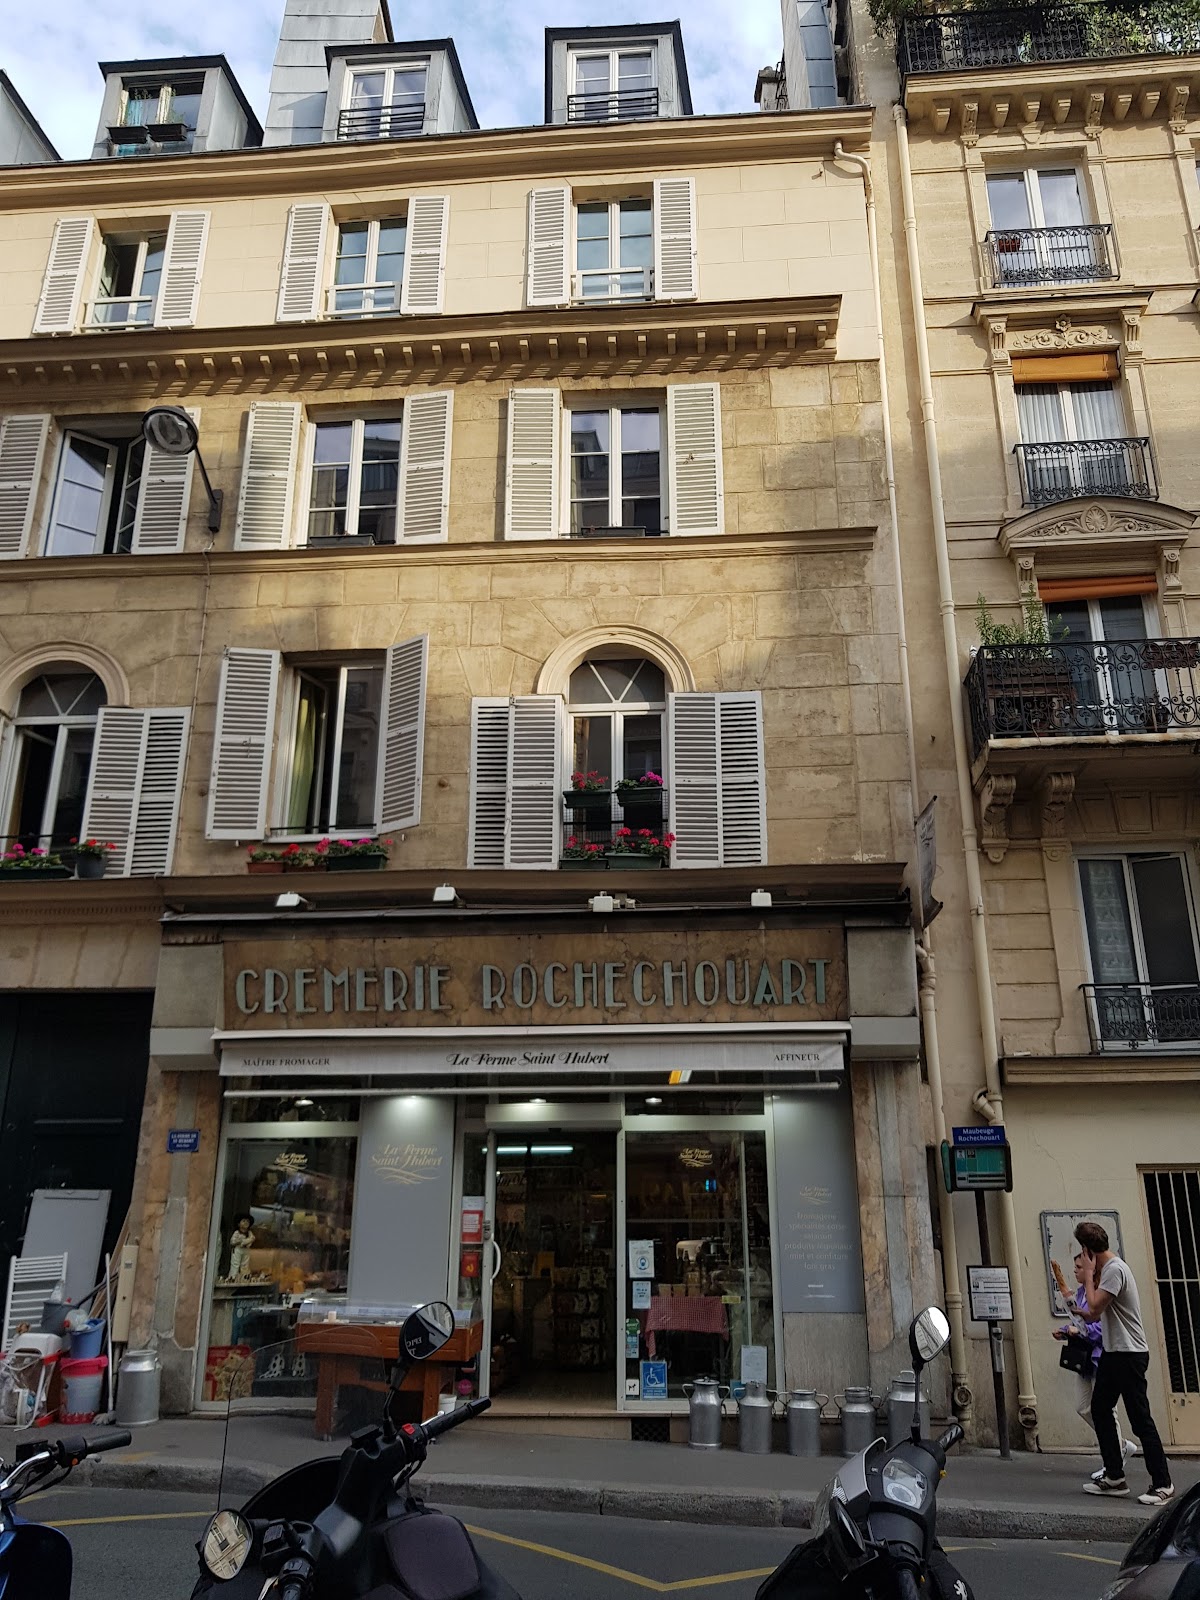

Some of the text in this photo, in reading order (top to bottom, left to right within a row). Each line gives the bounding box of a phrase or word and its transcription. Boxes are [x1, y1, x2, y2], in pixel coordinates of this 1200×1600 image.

[235, 957, 832, 1015] CREMERIE ROCHECHOUART
[279, 1057, 331, 1067] FROMAGER
[446, 1051, 610, 1066] La Ferme Saint Hubert
[774, 1053, 820, 1061] AFFINEUR
[959, 1134, 1000, 1142] Rochechouart
[382, 1143, 439, 1155] La Ferme
[370, 1153, 443, 1168] Saint Hubert
